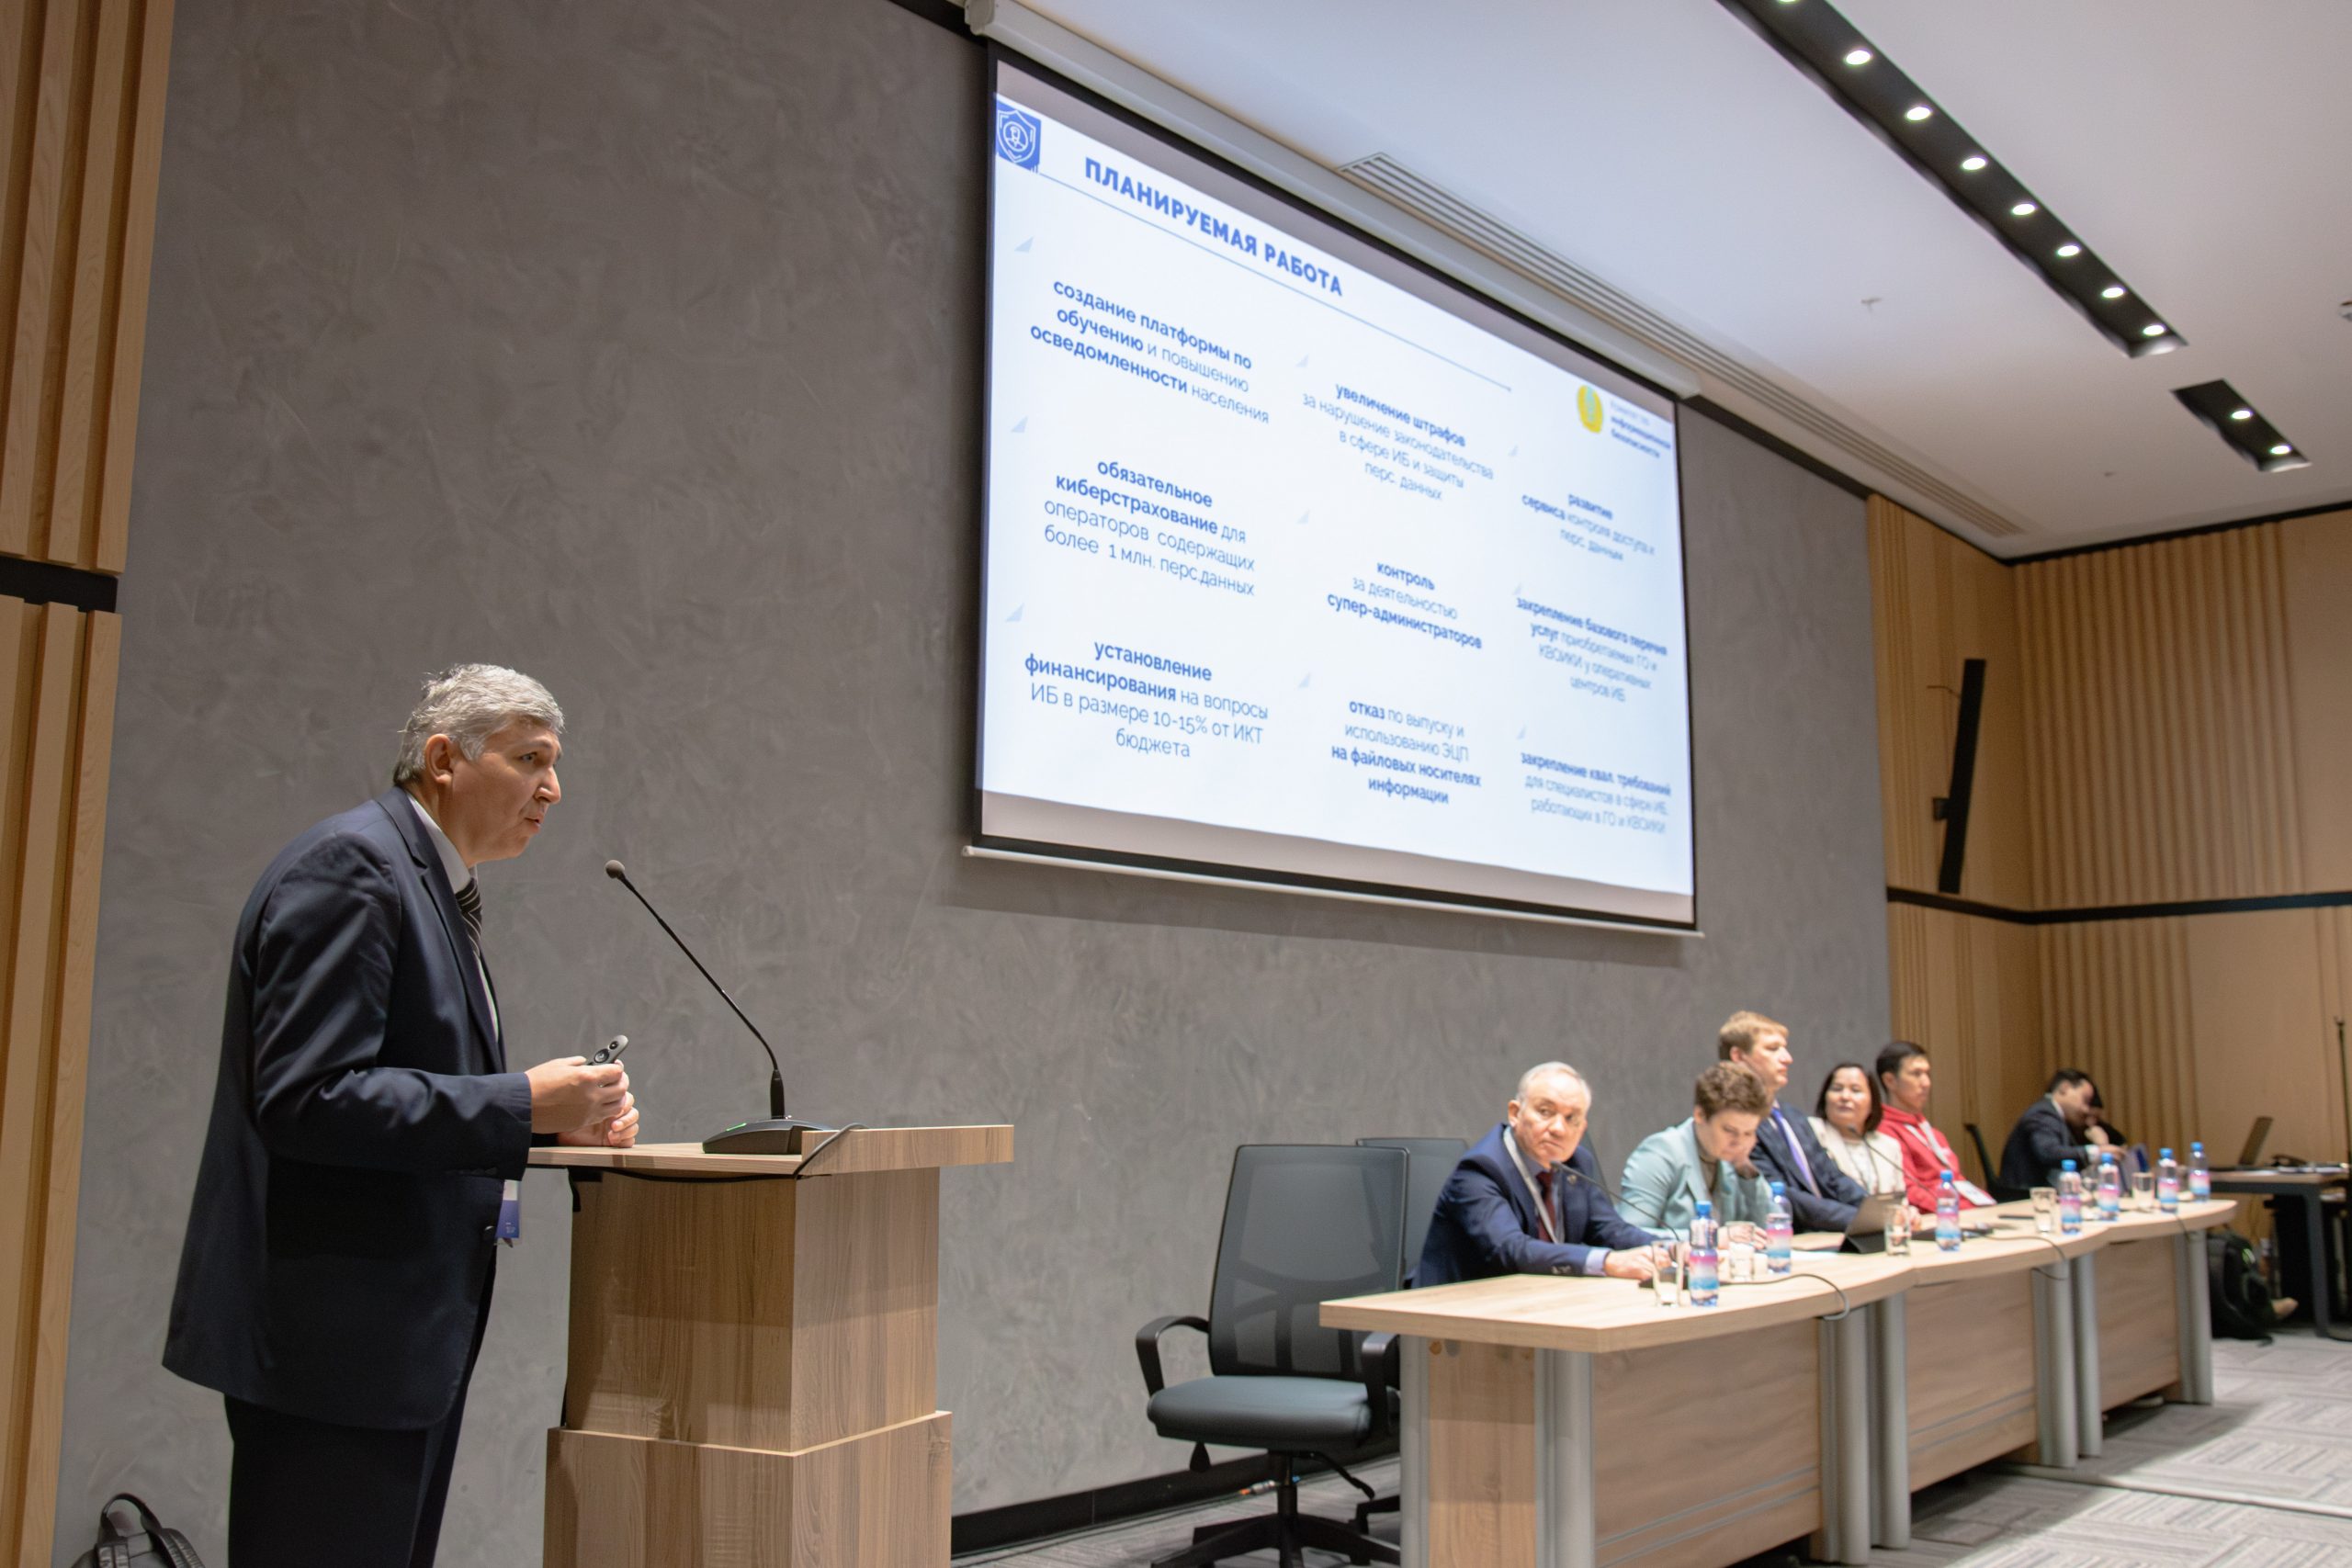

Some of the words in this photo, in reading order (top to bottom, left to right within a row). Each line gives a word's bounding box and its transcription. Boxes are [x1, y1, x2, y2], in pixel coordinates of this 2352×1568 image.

[1085, 157, 1257, 257] ПЛАНИРУЕМАЯ
[1264, 243, 1342, 297] РАБОТА
[1053, 280, 1136, 323] создание
[1140, 314, 1230, 361] платформы
[1234, 352, 1251, 369] по
[1031, 325, 1187, 393] осведомленности
[1192, 385, 1269, 424] населения
[1057, 309, 1144, 352] обучению
[1148, 343, 1158, 356] и
[1162, 347, 1249, 392] повышению
[1302, 393, 1317, 409] за
[1319, 400, 1390, 438] нарушение
[1335, 383, 1411, 424] увеличение
[1413, 416, 1466, 447] штрафов
[1097, 460, 1213, 508] обязательное
[1340, 431, 1346, 443] в
[1350, 434, 1390, 459] сфере
[1392, 448, 1410, 468] ИБ
[1413, 460, 1420, 471] и
[1424, 463, 1464, 489] защиты
[1364, 462, 1396, 484] перс.
[1057, 474, 1218, 535] киберстрахование
[1221, 525, 1247, 544] для
[1044, 500, 1149, 541] операторов
[1158, 532, 1255, 571] содержащих
[1045, 524, 1099, 554] более
[1109, 544, 1116, 558] 1
[1121, 547, 1155, 569] млн.
[1352, 577, 1365, 592] за
[1368, 582, 1458, 620] деятельностью
[1376, 562, 1435, 591] контроль
[1327, 592, 1483, 649] супер-администраторов
[1093, 641, 1213, 682] установление
[1024, 652, 1176, 702] финансирования
[1181, 689, 1199, 705] на
[1204, 694, 1269, 720] вопросы
[1031, 682, 1058, 705] ИБ
[1064, 692, 1073, 706] в
[1079, 694, 1148, 725] размере
[1153, 710, 1208, 735] 10-15%
[1212, 721, 1229, 738] от
[1233, 723, 1263, 744] ИКТ
[1349, 700, 1385, 720] отказ
[1387, 708, 1403, 724] по
[1407, 713, 1453, 739] выпуску
[1457, 726, 1464, 738] и
[1115, 728, 1191, 758] бюджета
[1331, 745, 1348, 761] на
[1351, 747, 1416, 774] файловых
[1419, 762, 1482, 787] носителях
[1344, 724, 1440, 756] использованию
[1442, 742, 1470, 762] ЭЦП
[1368, 777, 1449, 805] информации
